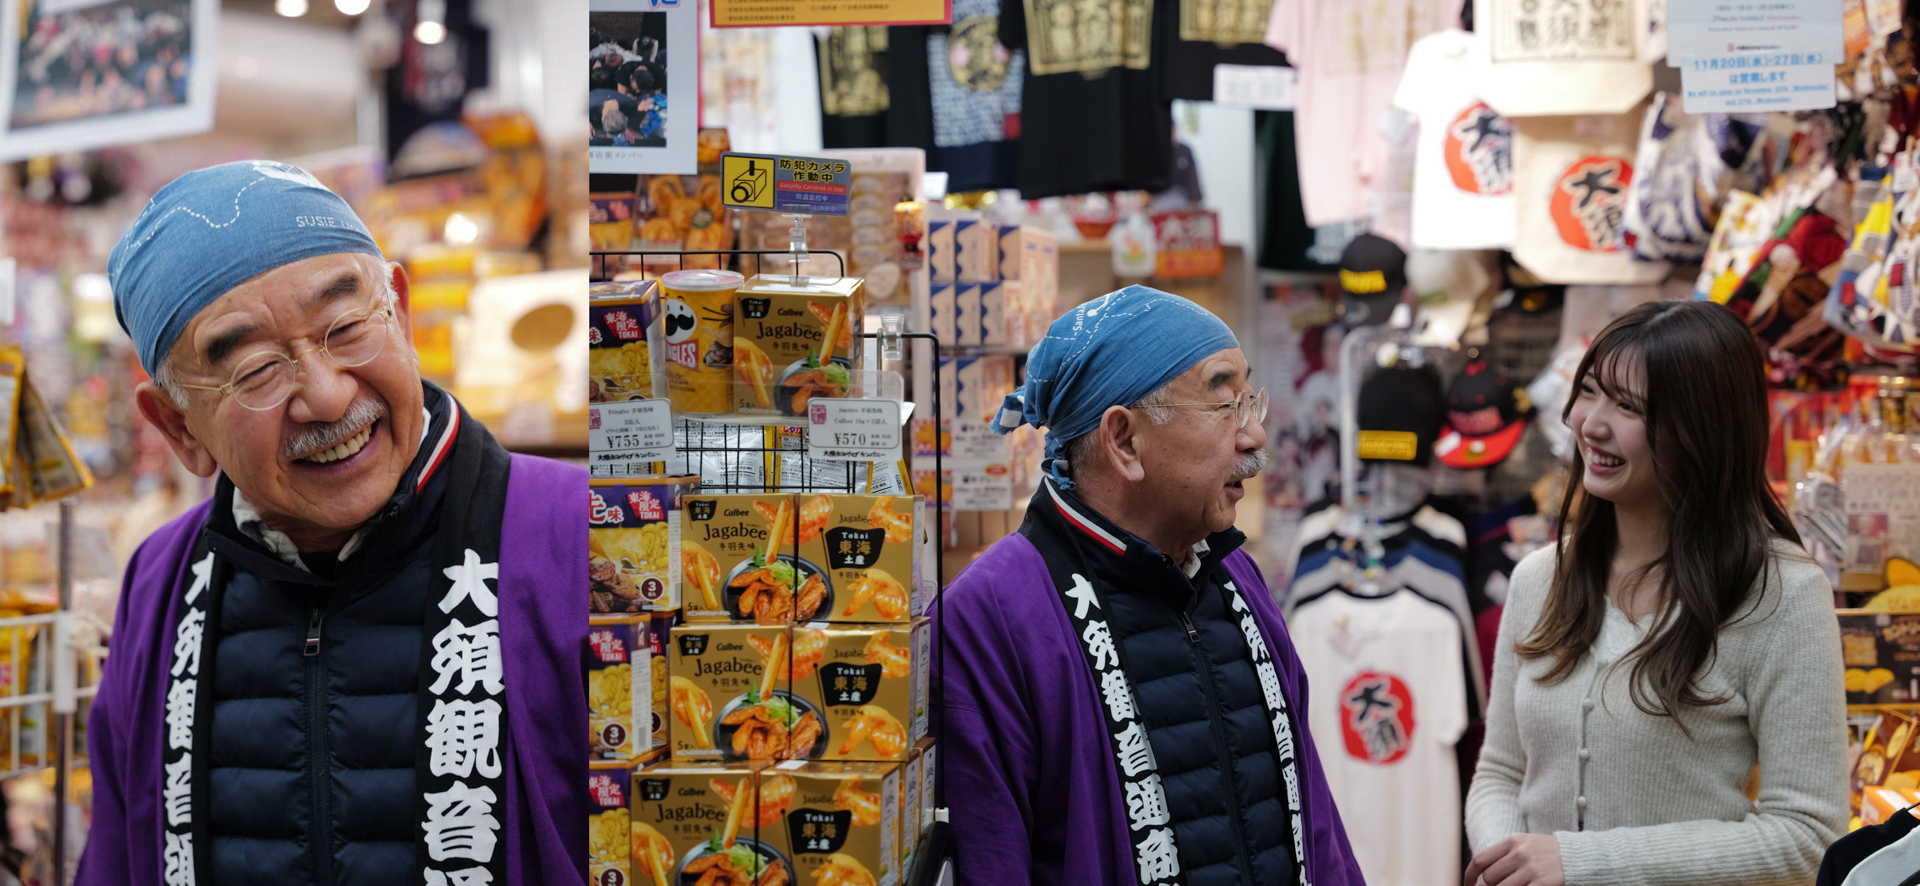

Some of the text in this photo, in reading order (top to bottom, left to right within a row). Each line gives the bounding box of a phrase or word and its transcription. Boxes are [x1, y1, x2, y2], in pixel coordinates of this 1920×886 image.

[1729, 71, 1786, 84] は営業します
[780, 159, 845, 173] 防犯カメラ
[794, 171, 833, 183] 作動中
[780, 182, 801, 190] Security
[295, 215, 336, 228] SUSIE
[605, 311, 627, 324] 東海
[777, 308, 804, 317] Calbee
[616, 318, 639, 331] 限定
[618, 330, 638, 339] TOKAI
[756, 321, 822, 342] Jagabee
[773, 341, 809, 352] 手羽先味
[607, 434, 639, 448] ¥755
[834, 433, 866, 446] ¥570
[629, 490, 652, 504] 東海
[639, 499, 661, 512] 限定
[640, 511, 660, 520] TOKAI
[724, 509, 749, 517] Calbee
[703, 522, 767, 541] Jagabee
[719, 542, 756, 551] 手羽先味
[838, 540, 872, 555] 東海
[844, 555, 865, 565] 土産
[648, 581, 657, 592] 3
[589, 630, 613, 645] 東海
[600, 639, 624, 653] 限定
[716, 643, 743, 651] Calbee
[601, 652, 623, 661] TOKAI
[694, 657, 763, 677] Jagabee
[836, 667, 865, 675] Tokai
[711, 678, 750, 687] 手羽先味
[833, 676, 867, 691] 東海
[839, 691, 861, 702] 土産
[421, 548, 505, 886] 大須観音
[609, 727, 619, 738] 3
[1065, 573, 1181, 886] 大須観音通商
[589, 775, 611, 789] 東海
[598, 784, 621, 798] 限定
[678, 787, 706, 797] Calbee
[599, 797, 620, 806] TOKAI
[656, 803, 725, 823] Jagabee
[805, 813, 834, 822] Tokai
[673, 824, 712, 834] 手羽先味
[802, 823, 837, 839] 東海
[807, 838, 830, 850] 土産
[608, 872, 617, 882] 3
